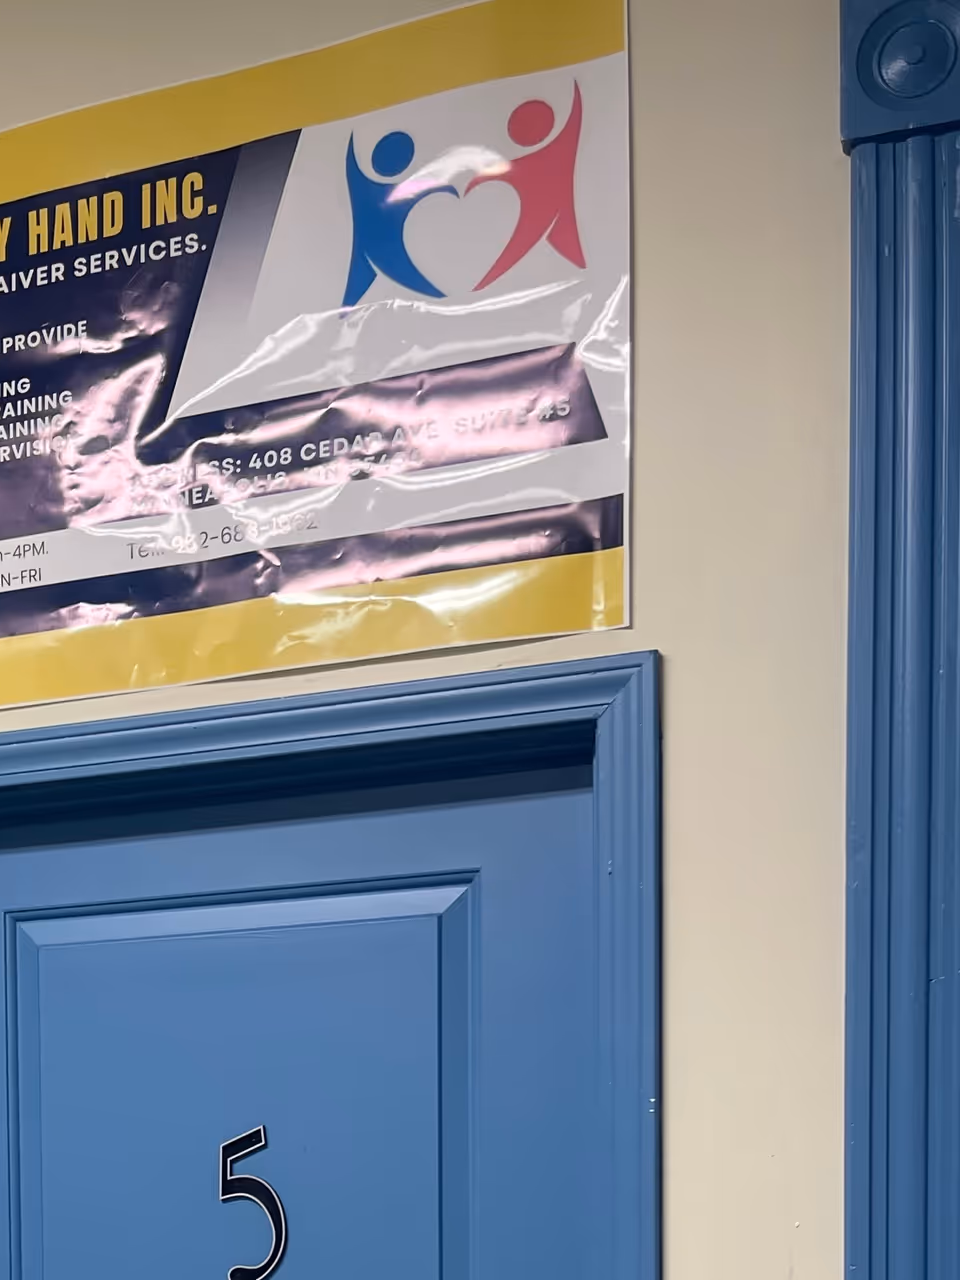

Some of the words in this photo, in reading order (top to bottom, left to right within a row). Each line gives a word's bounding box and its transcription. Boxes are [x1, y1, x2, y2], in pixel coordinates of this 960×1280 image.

[28, 190, 124, 253] HAND
[141, 172, 217, 228] INC.
[74, 233, 207, 277] SERVICES.
[2, 321, 87, 353] PROVIDE
[248, 447, 293, 471] 408
